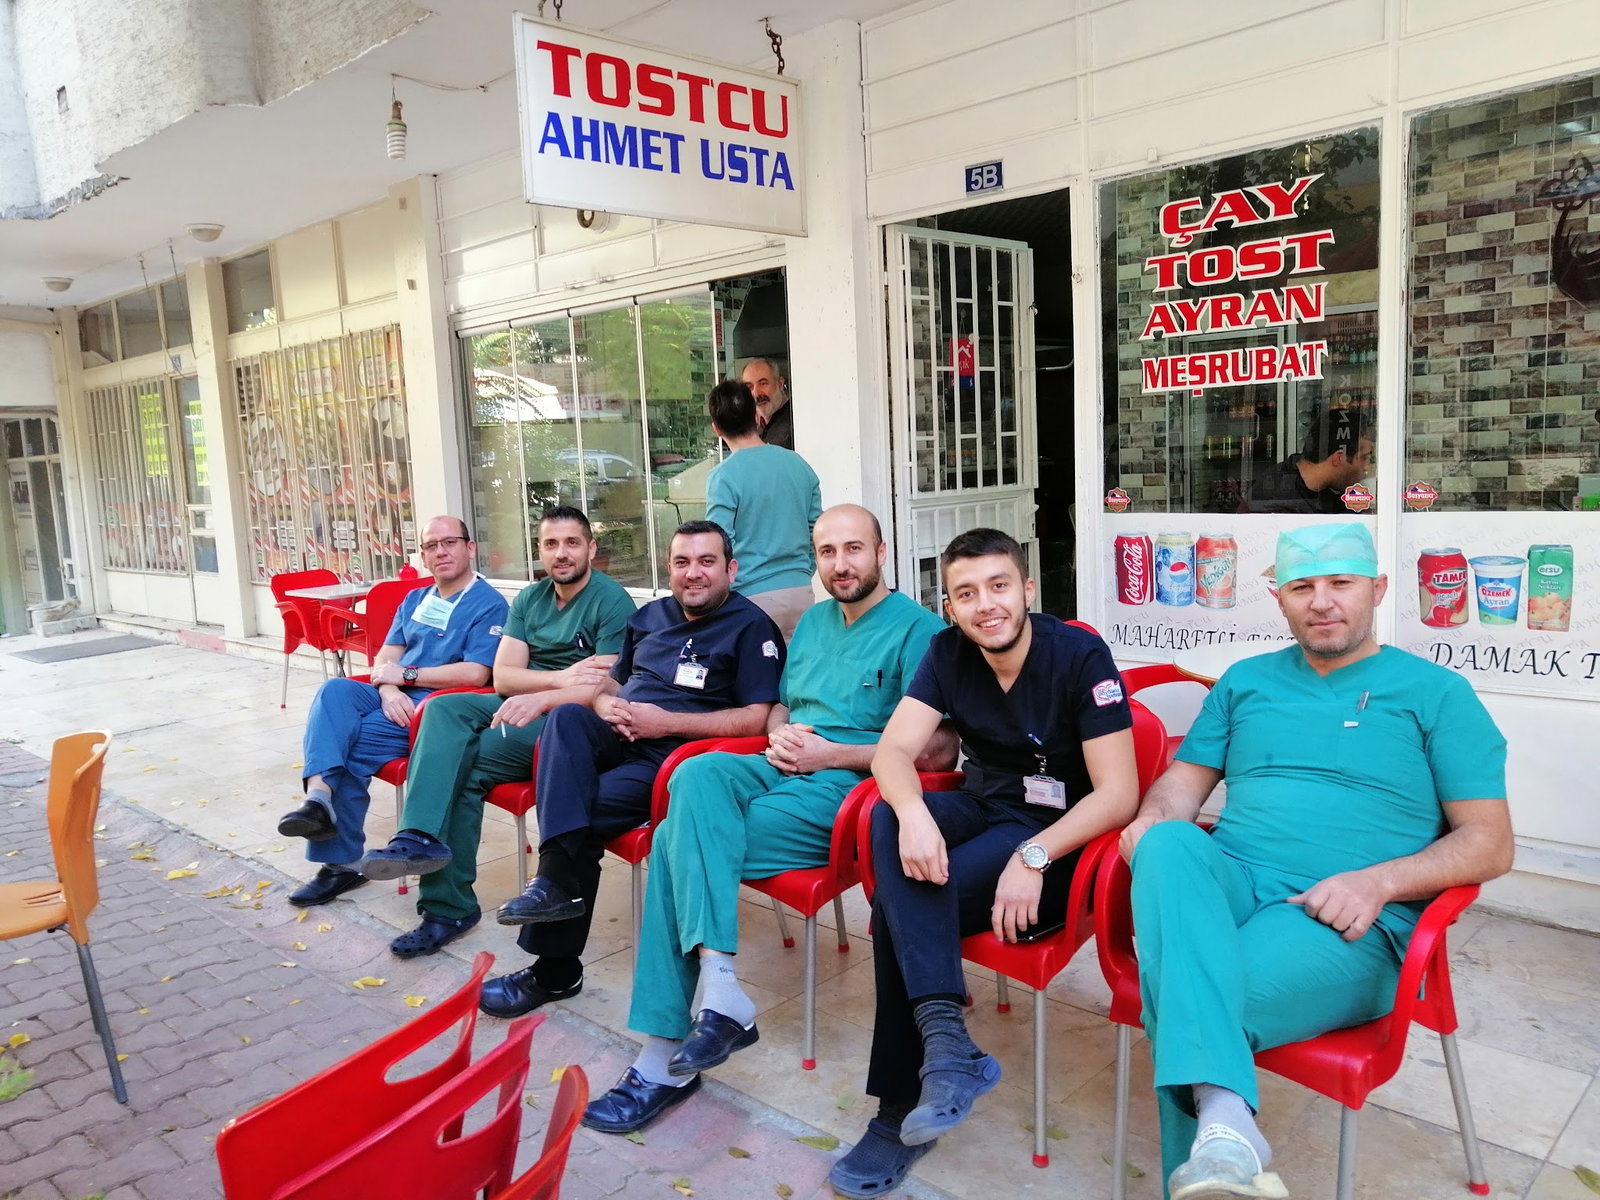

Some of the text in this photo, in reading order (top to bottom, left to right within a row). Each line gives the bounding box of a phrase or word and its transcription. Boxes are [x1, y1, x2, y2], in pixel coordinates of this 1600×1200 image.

[537, 40, 789, 139] TOSTCU
[538, 111, 795, 191] AHMET USTA
[970, 165, 998, 191] 5B
[1159, 173, 1325, 247] ÇAY
[1145, 229, 1336, 293] TOST
[1139, 282, 1329, 341] AYRAN
[1141, 340, 1328, 397] MEŞRUBAT
[1483, 597, 1510, 606] Ayran
[1430, 642, 1570, 678] DAMAK
